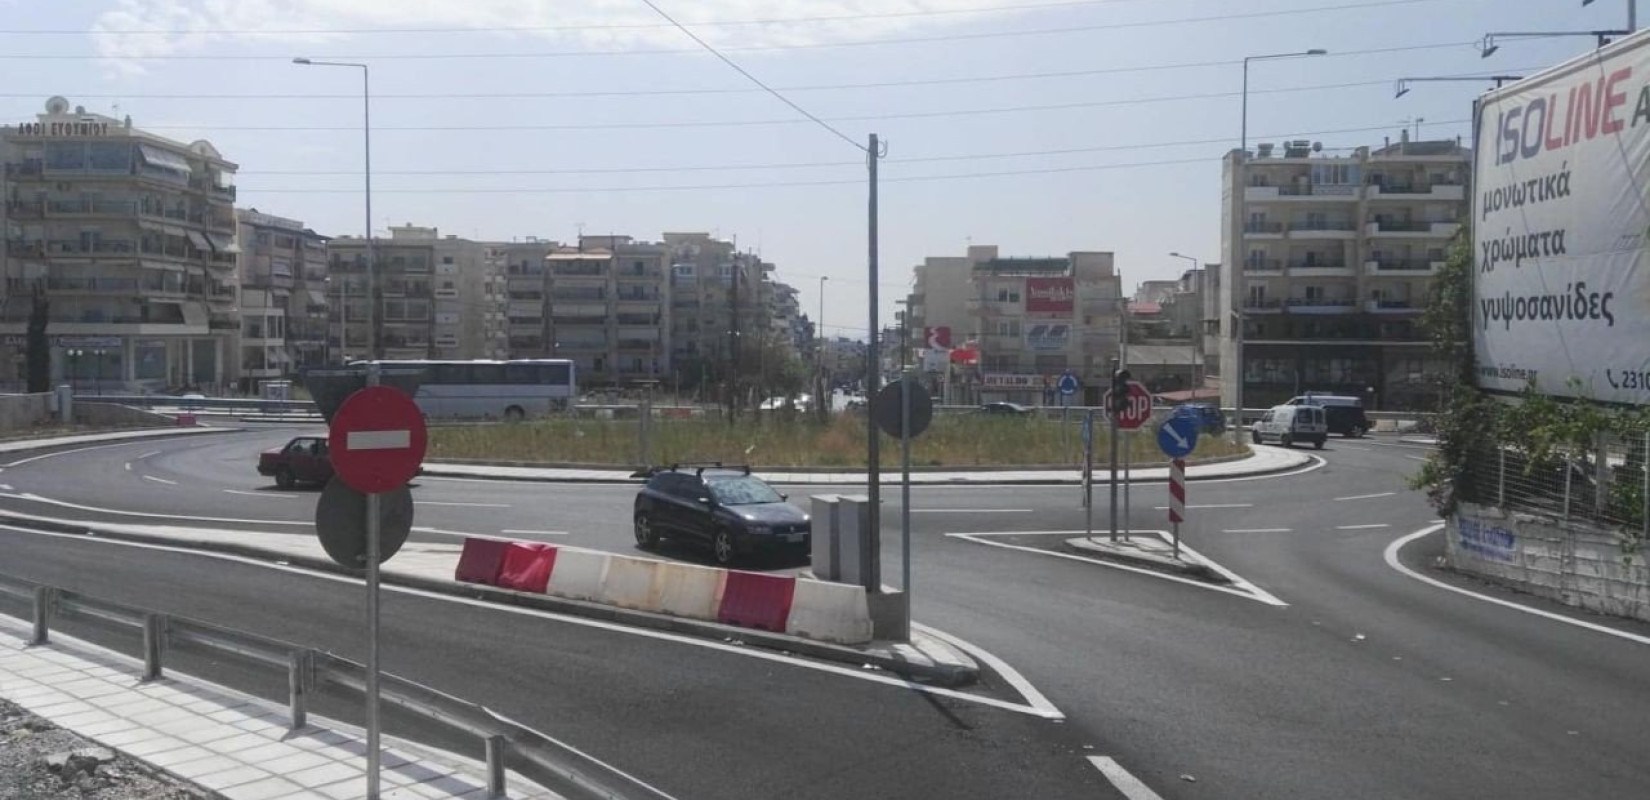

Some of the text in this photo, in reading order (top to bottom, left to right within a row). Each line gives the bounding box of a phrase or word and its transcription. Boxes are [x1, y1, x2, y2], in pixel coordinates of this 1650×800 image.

[1495, 66, 1632, 166] ISOLINE
[1482, 161, 1571, 219] μονωτικά
[1481, 226, 1566, 273] χρώματα
[1481, 281, 1614, 330] γυψοσανίδες
[1108, 396, 1148, 421] OP
